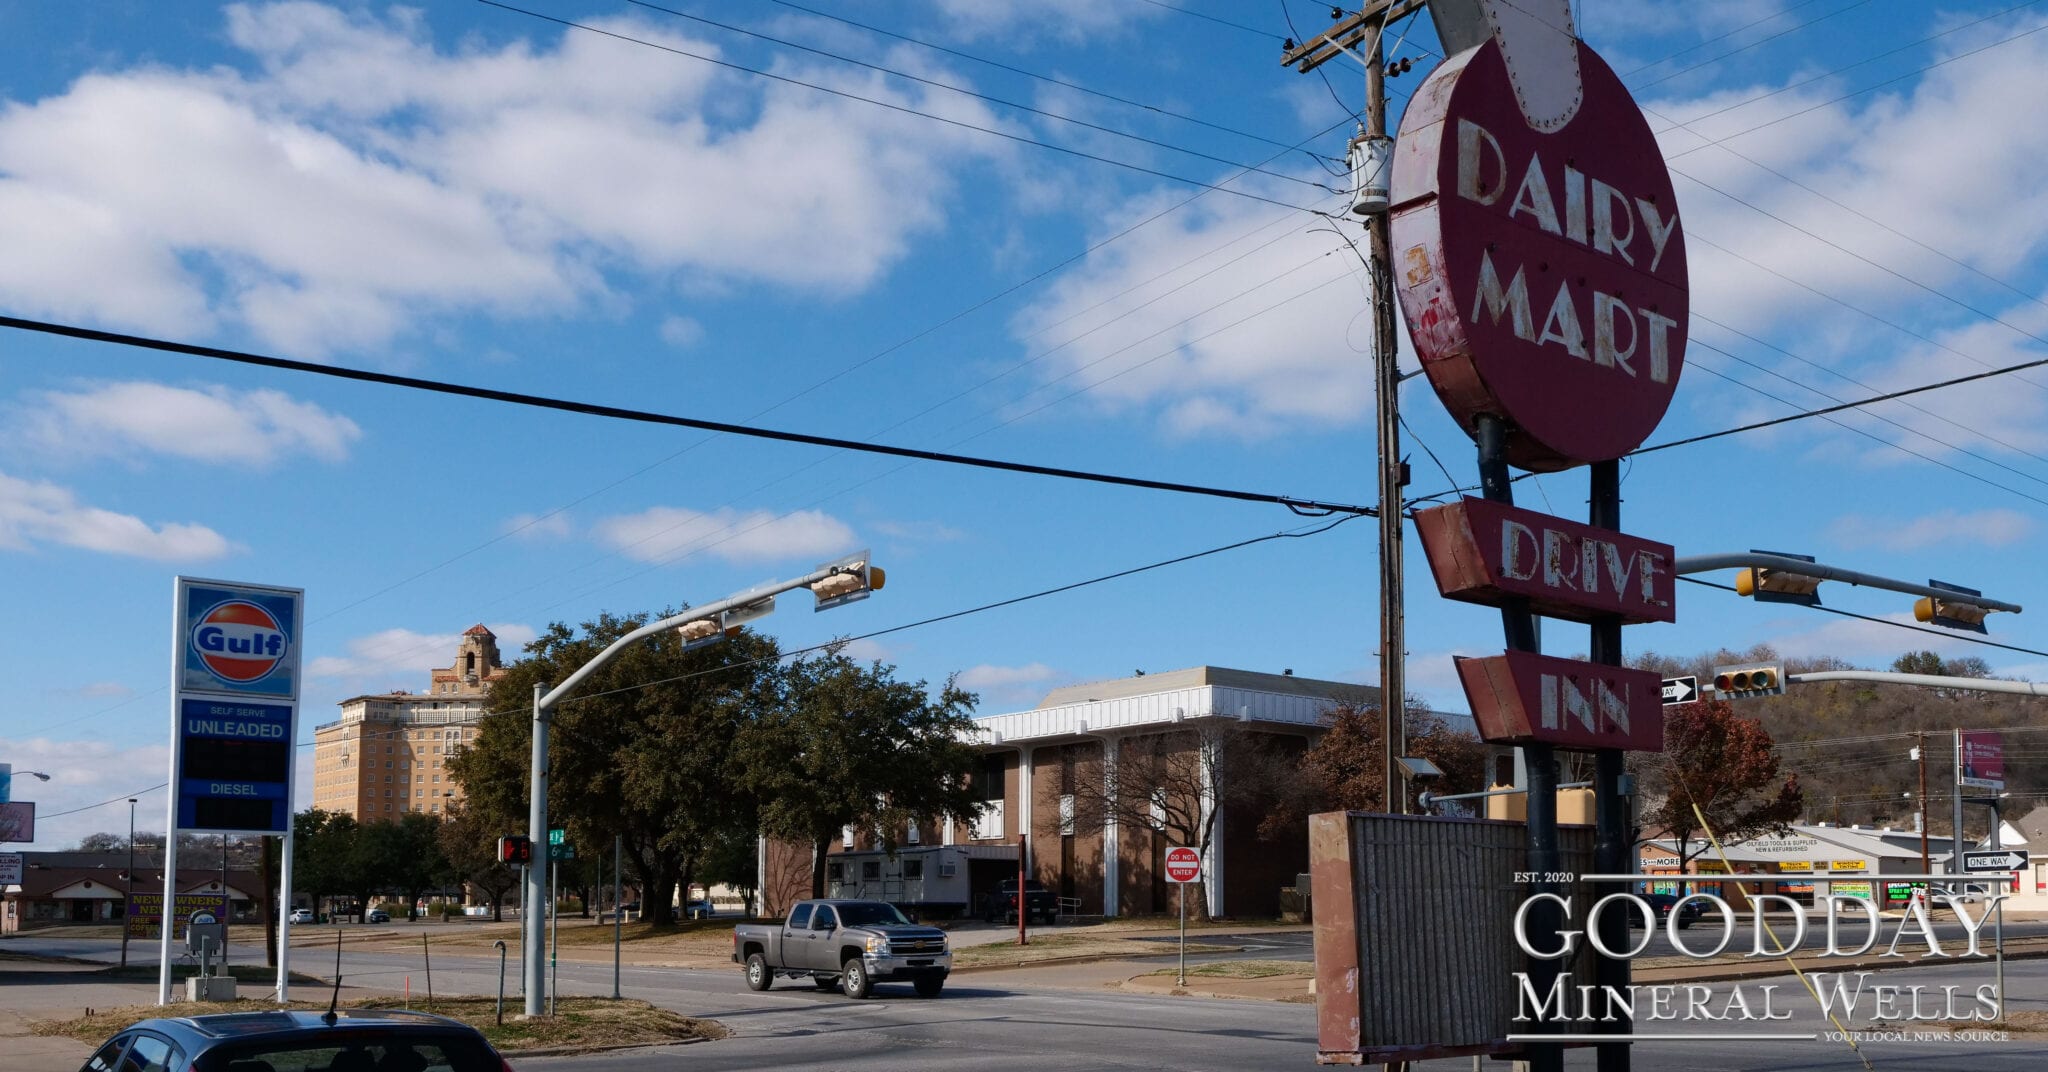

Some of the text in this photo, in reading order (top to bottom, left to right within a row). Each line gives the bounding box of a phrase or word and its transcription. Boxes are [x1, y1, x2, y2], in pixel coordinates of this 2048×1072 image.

[1457, 118, 1677, 273] DAIRY
[1471, 248, 1678, 384] MART
[1502, 518, 1668, 607] DRIVE
[197, 626, 282, 656] Gulf
[210, 706, 266, 717] SELF SERVE
[1540, 673, 1630, 737] INN
[188, 719, 284, 738] UNLEADED
[210, 783, 258, 795] DIESEL
[1656, 858, 1680, 866] MORE
[1969, 856, 2009, 867] ONE WAY
[133, 895, 223, 905] NEW WNERS
